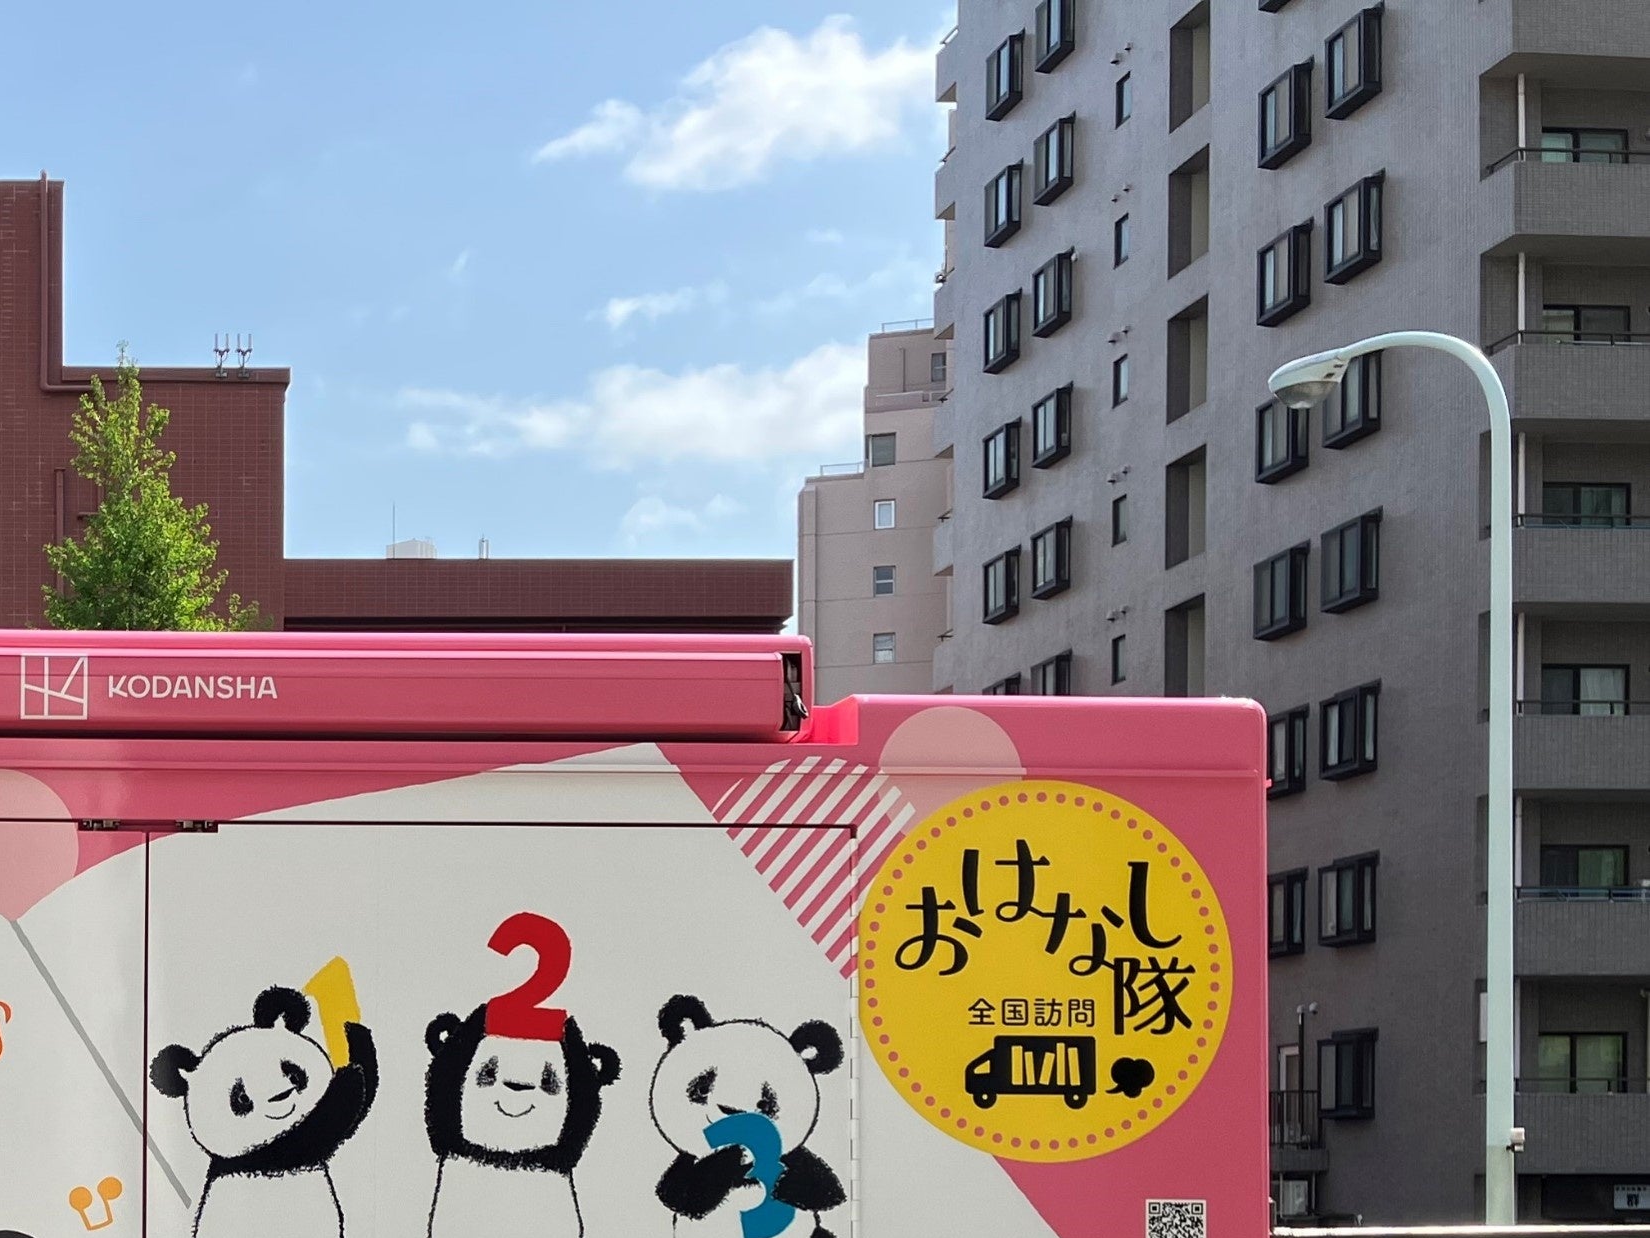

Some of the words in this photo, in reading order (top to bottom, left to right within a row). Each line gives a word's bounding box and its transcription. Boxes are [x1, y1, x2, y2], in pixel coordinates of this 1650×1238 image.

[108, 675, 278, 699] KODANSHA
[486, 912, 572, 1041] 2
[968, 998, 1095, 1028] 全国訪問
